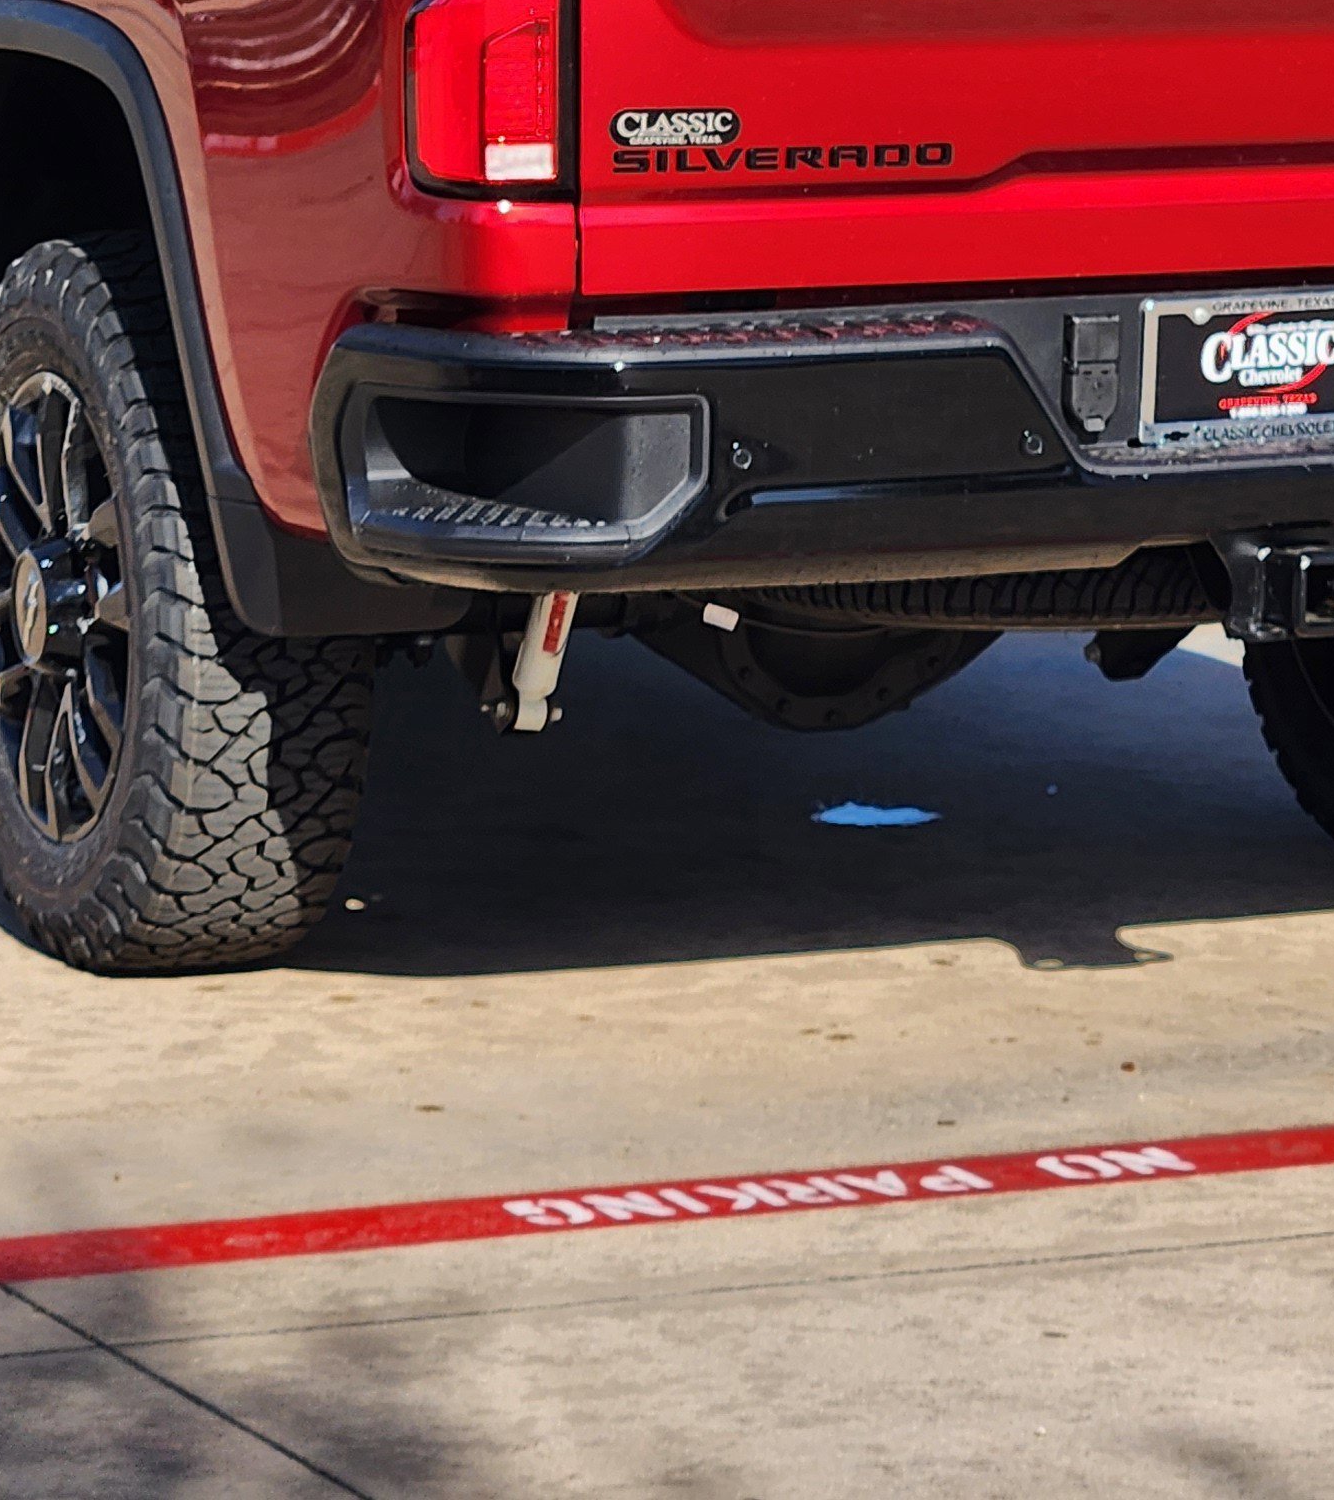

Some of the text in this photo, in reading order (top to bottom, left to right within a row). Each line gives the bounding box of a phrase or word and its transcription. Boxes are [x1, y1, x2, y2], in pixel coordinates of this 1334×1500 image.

[616, 111, 733, 138] CLASSIC
[612, 142, 953, 174] SILVERADO
[1238, 366, 1304, 387] Chevrolet
[1203, 424, 1260, 441] CLASSIC
[1035, 1146, 1197, 1180] NO
[502, 1164, 993, 1226] PARKING
